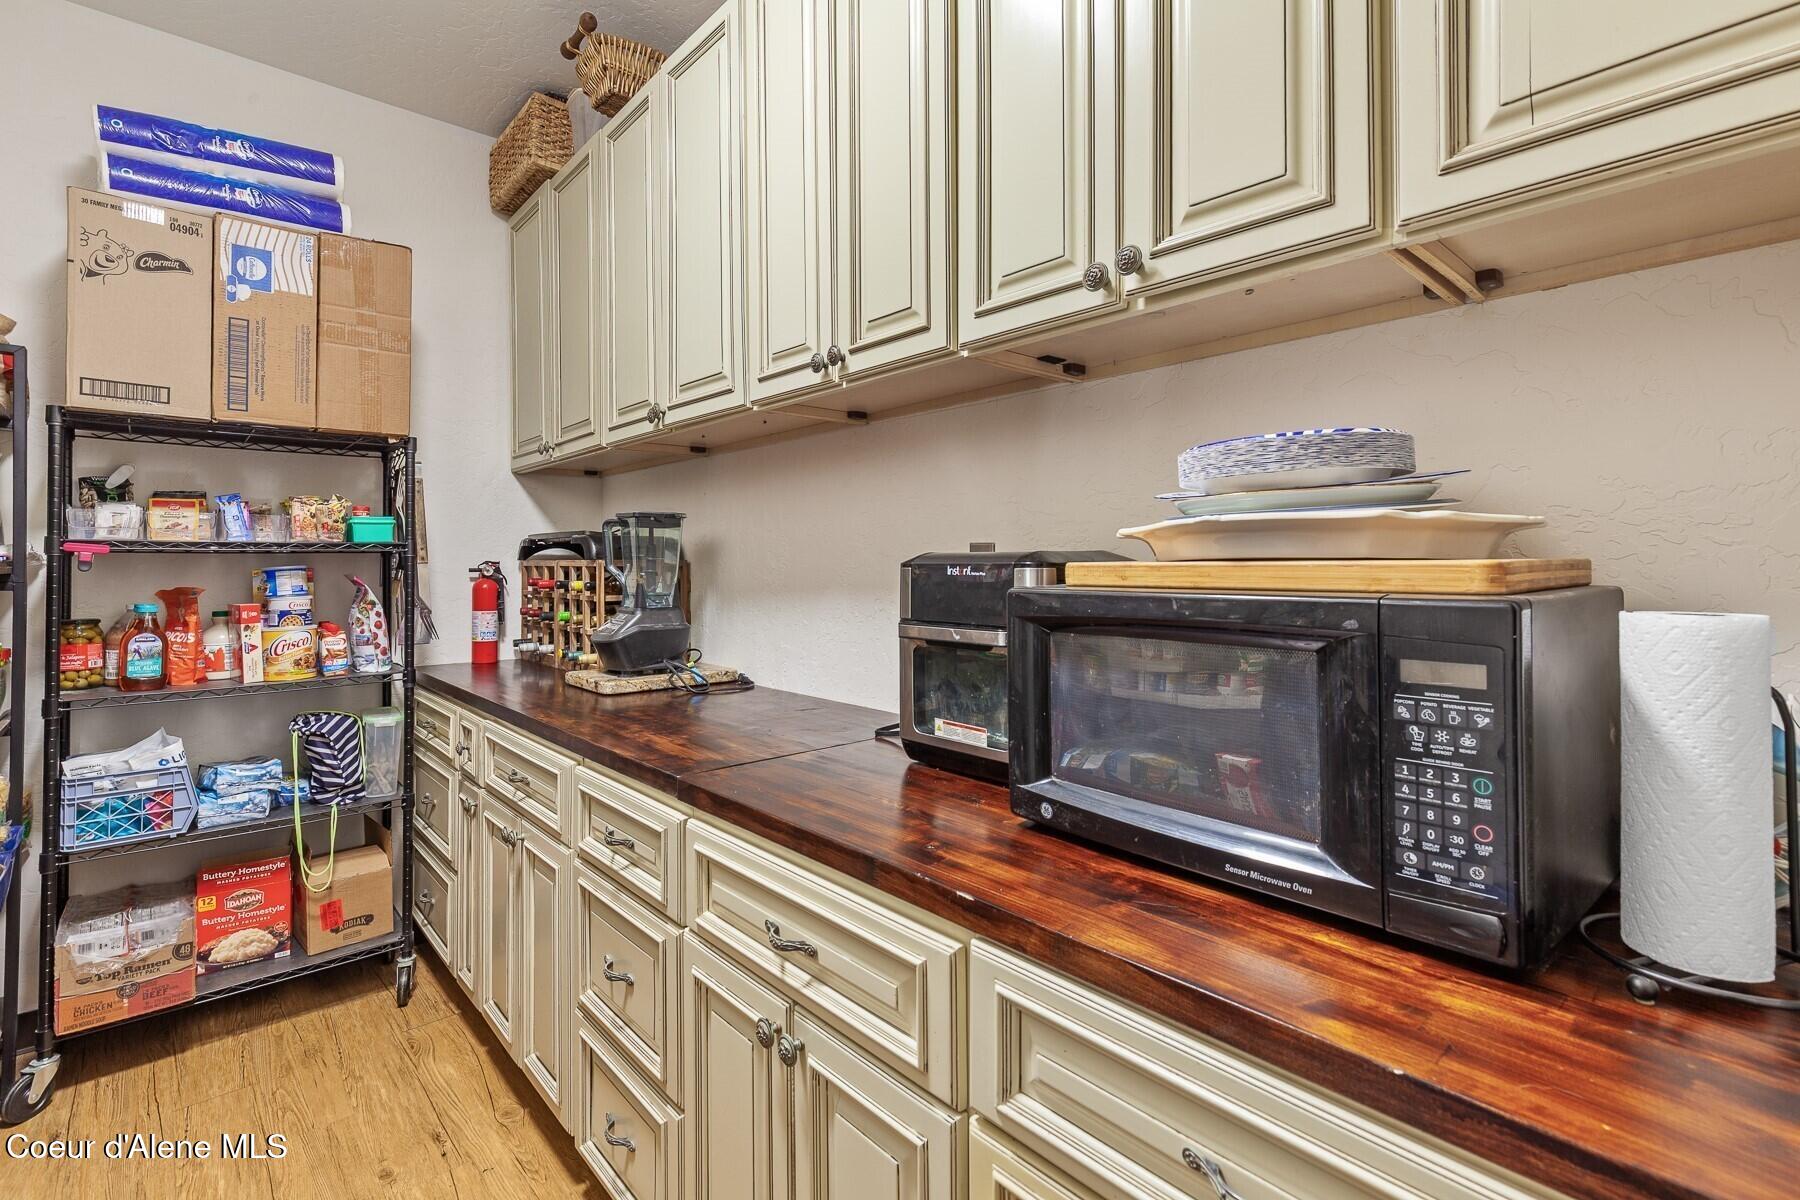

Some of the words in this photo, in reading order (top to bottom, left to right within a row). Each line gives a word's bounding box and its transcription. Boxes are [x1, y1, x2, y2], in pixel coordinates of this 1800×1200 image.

[90, 200, 109, 209] FAMILY
[169, 222, 199, 238] 04904
[139, 257, 180, 269] Charmin
[288, 601, 309, 609] Crisco
[274, 636, 309, 657] Crisco
[1401, 765, 1409, 775] 1
[1426, 768, 1434, 779] 2
[1452, 772, 1460, 783] 3
[1401, 784, 1410, 794] 4
[1426, 788, 1434, 798] 5
[1452, 792, 1461, 803] 6
[1474, 796, 1492, 804] START
[1474, 803, 1492, 811] PAUSE
[1402, 805, 1410, 815] 7
[1426, 810, 1435, 820] 8
[1452, 815, 1461, 825] 9
[1426, 829, 1435, 840] 0
[1422, 841, 1440, 849] DISPLAY
[1474, 843, 1493, 853] CLEAR
[1477, 849, 1490, 857] OFF
[203, 870, 237, 881] Buttery
[238, 861, 286, 876] Homestyle
[1431, 860, 1455, 871] AM/PM
[241, 872, 271, 880] POTATOES
[1224, 863, 1249, 877] Sensor
[1249, 870, 1291, 889] Microwave
[1292, 882, 1313, 895] Oven
[1468, 881, 1486, 889] CLOCK
[200, 897, 214, 907] 12
[226, 893, 262, 909] IDAHOAN
[202, 915, 236, 926] Buttery
[238, 905, 285, 919] Homestyle
[216, 922, 240, 930] MASHED
[241, 916, 271, 924] POTATOES
[339, 916, 366, 931] KODIAK
[179, 945, 191, 955] 48
[95, 970, 121, 981] Top
[124, 958, 172, 974] Ramen
[118, 972, 142, 981] VARIETY
[145, 968, 161, 976] PACK
[143, 987, 168, 1000] BEEF
[73, 1002, 113, 1018] CHICKEN
